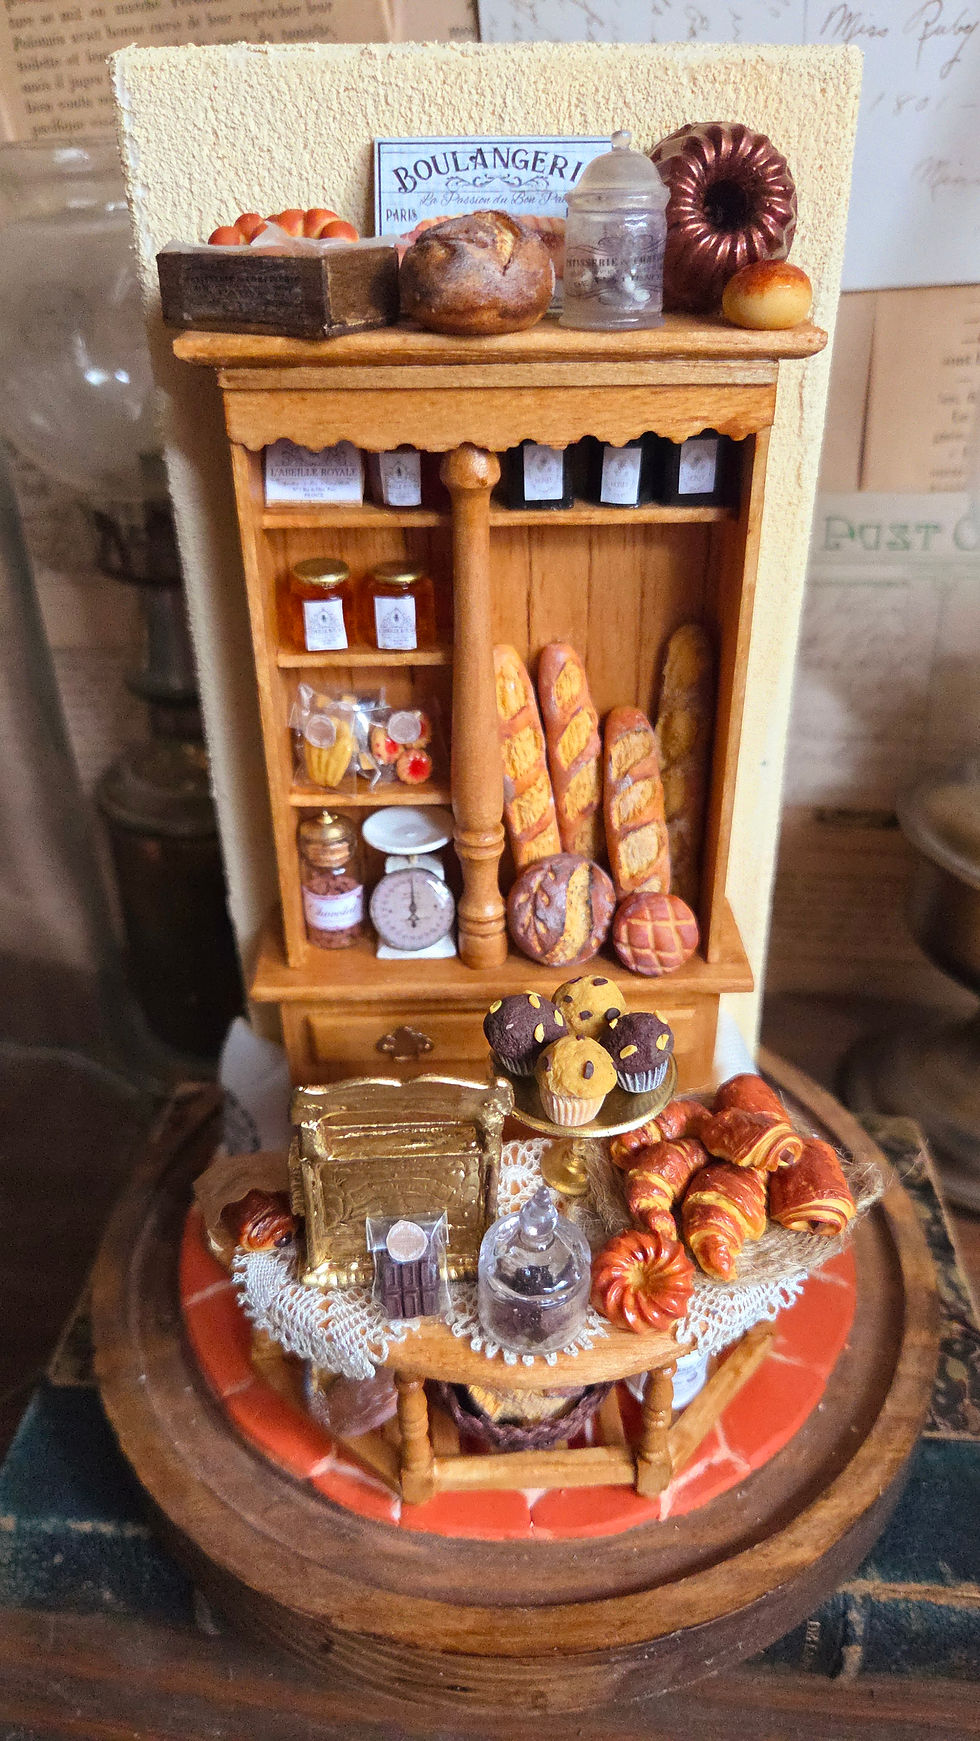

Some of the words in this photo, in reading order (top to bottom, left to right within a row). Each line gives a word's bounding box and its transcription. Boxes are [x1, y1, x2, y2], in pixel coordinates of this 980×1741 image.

[392, 146, 583, 194] BOULANGERI
[419, 191, 439, 206] La
[441, 191, 491, 206] Passion
[492, 191, 508, 205] du
[510, 190, 536, 205] Bon
[539, 190, 565, 205] Pai
[386, 208, 418, 222] PARIS
[270, 467, 318, 477] L'ABEILLE
[320, 467, 358, 477] ROYALE
